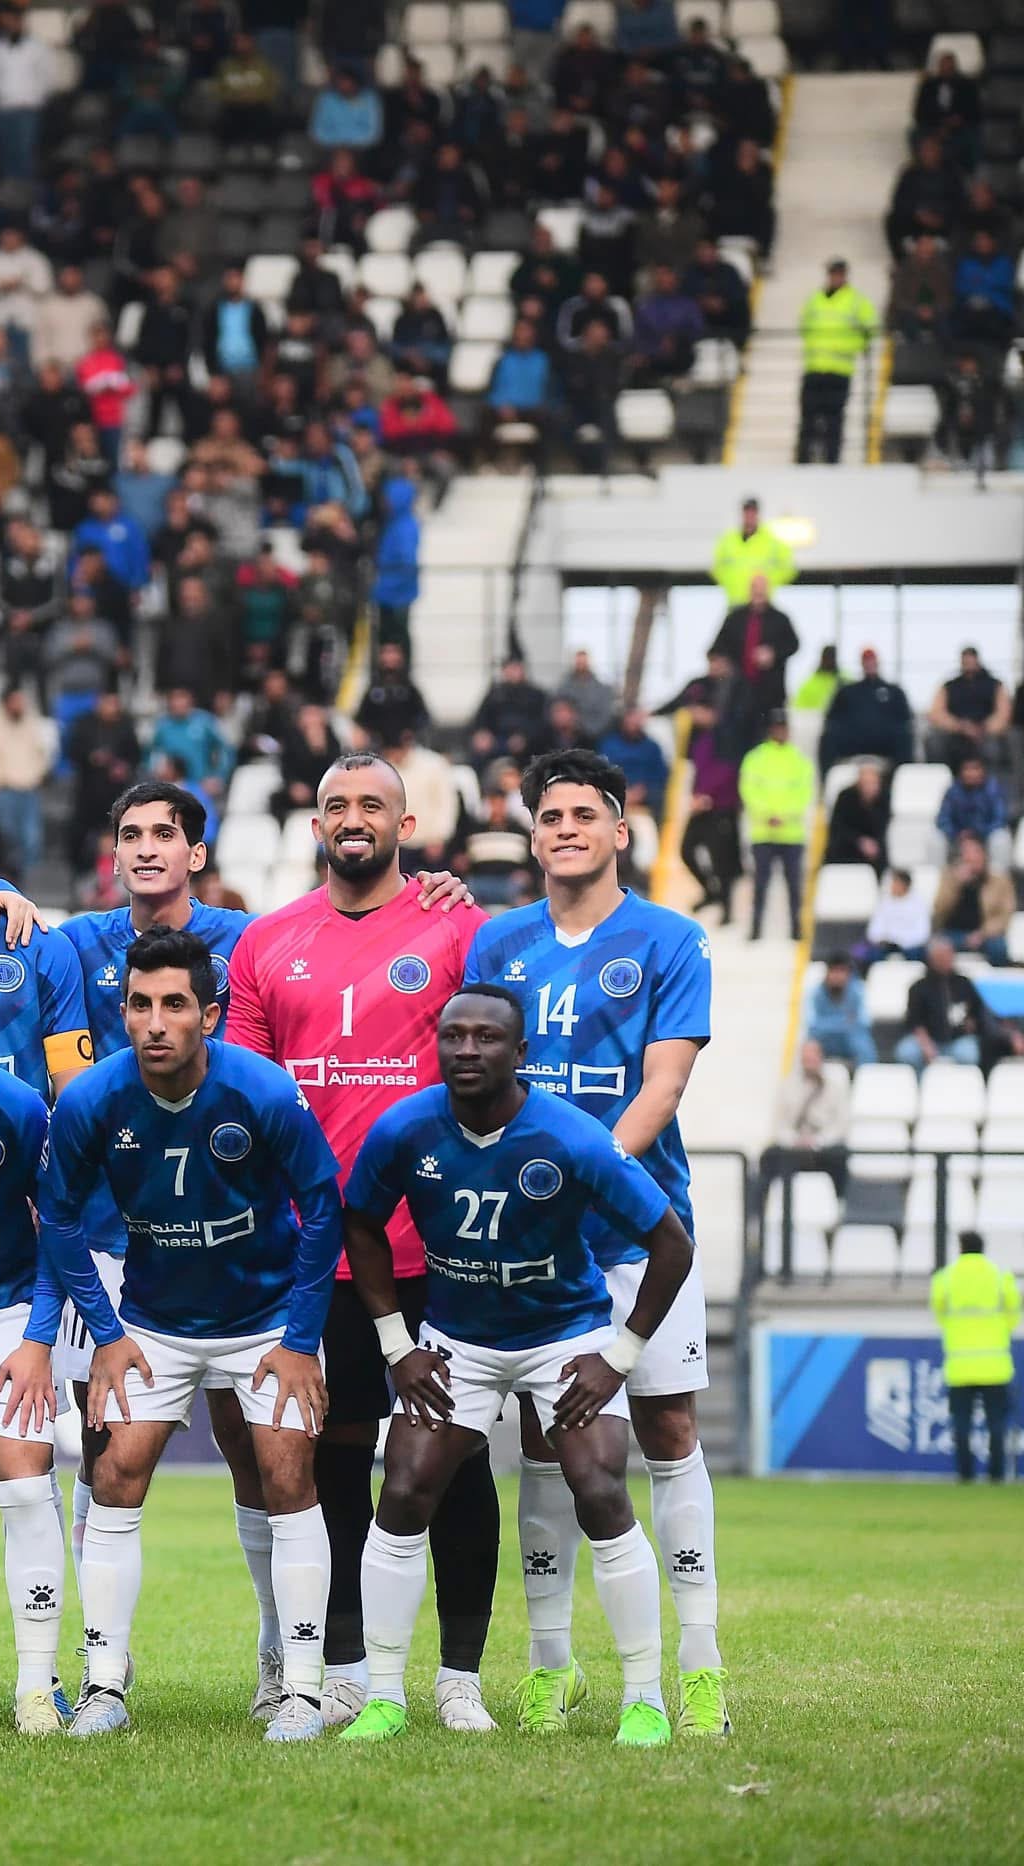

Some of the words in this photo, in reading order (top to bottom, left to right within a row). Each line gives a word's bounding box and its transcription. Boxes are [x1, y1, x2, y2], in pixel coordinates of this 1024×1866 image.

[339, 983, 354, 1037] 1
[536, 982, 580, 1036] 14
[77, 1034, 93, 1060] C
[328, 1054, 417, 1068] المنصة
[515, 1062, 568, 1077] المنص
[328, 1071, 417, 1086] Almanasa
[164, 1147, 190, 1196] 7
[416, 1169, 443, 1180] KELME
[454, 1189, 509, 1240] 27
[25, 1602, 56, 1610] KELME
